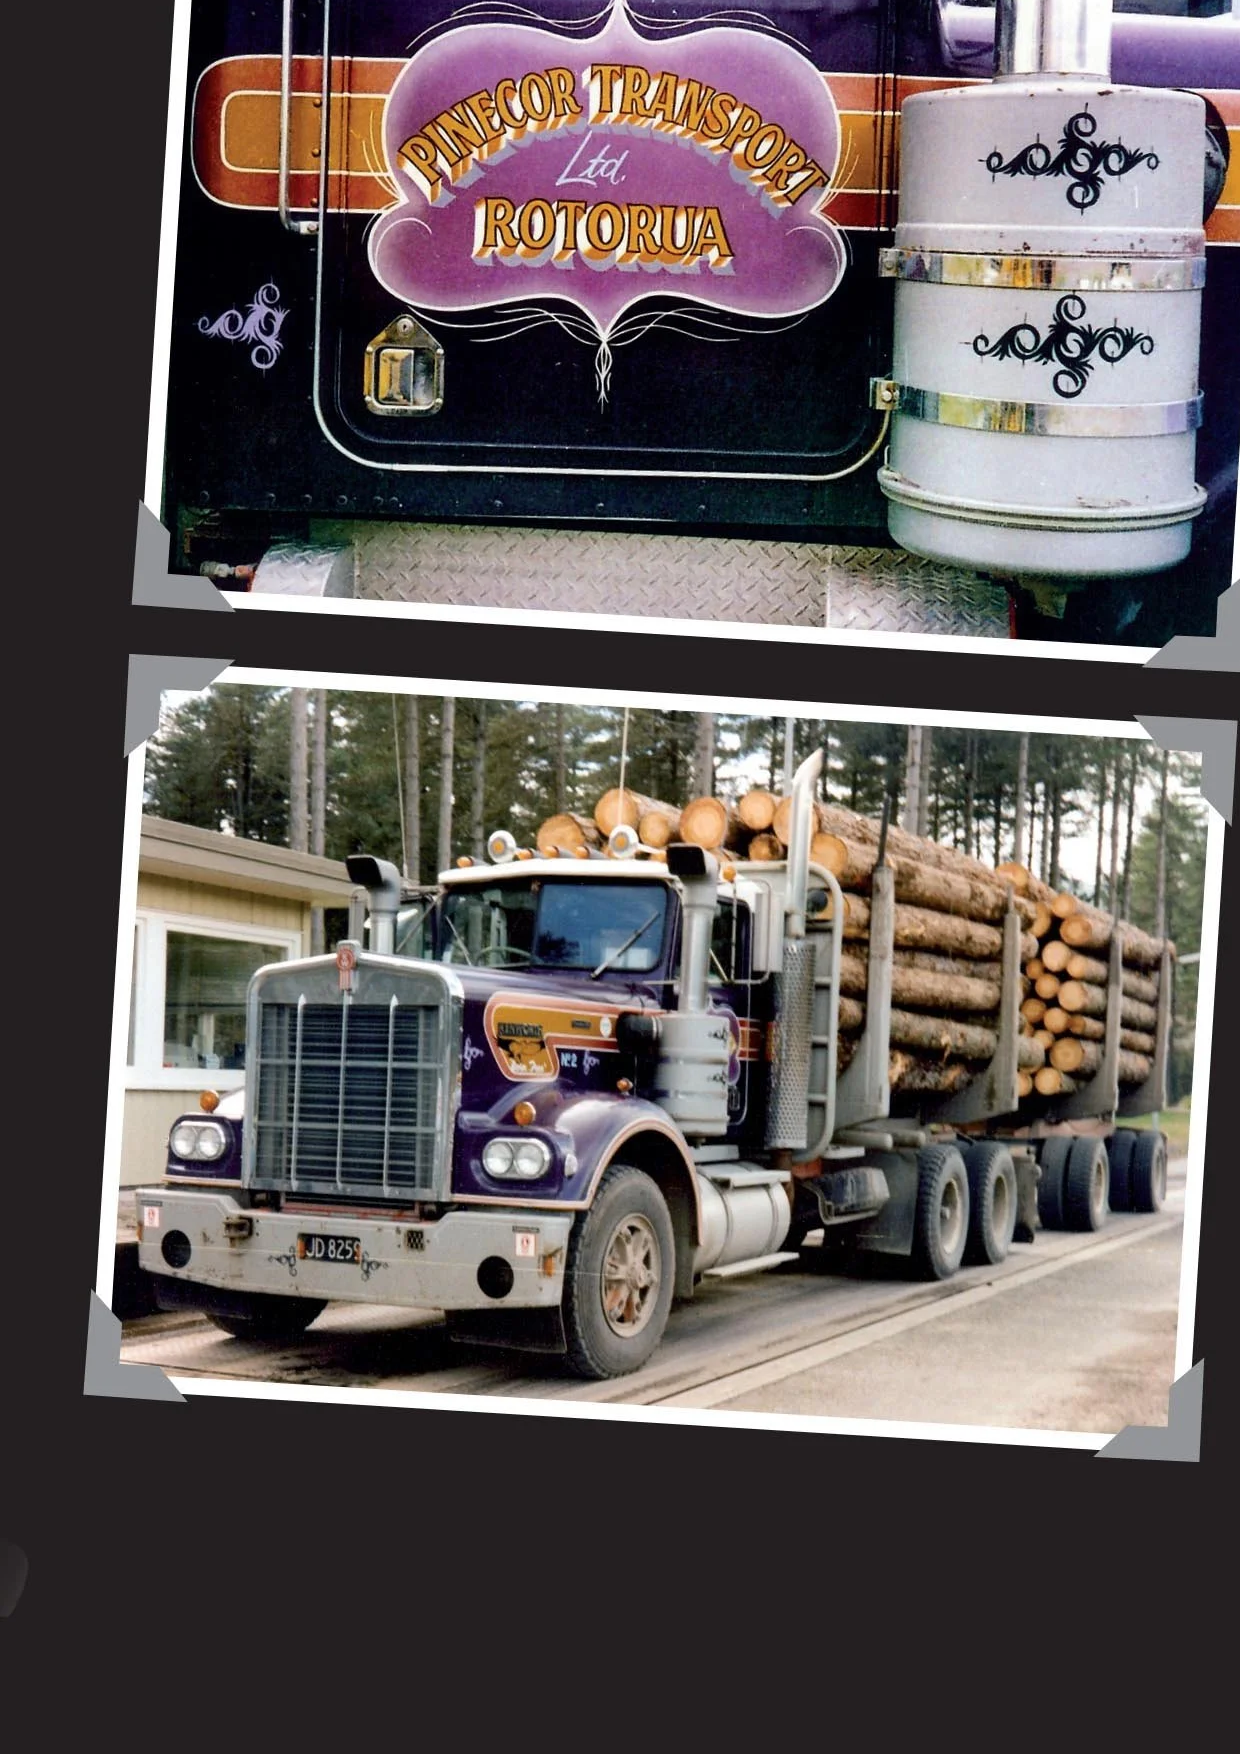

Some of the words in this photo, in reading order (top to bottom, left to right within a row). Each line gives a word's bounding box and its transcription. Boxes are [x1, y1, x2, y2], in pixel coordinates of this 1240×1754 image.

[397, 66, 585, 201] PINECOR
[584, 63, 831, 208] TRANSPORT
[555, 130, 628, 188] Ltd.
[474, 196, 735, 266] ROTORUA
[306, 1237, 325, 1258] JD
